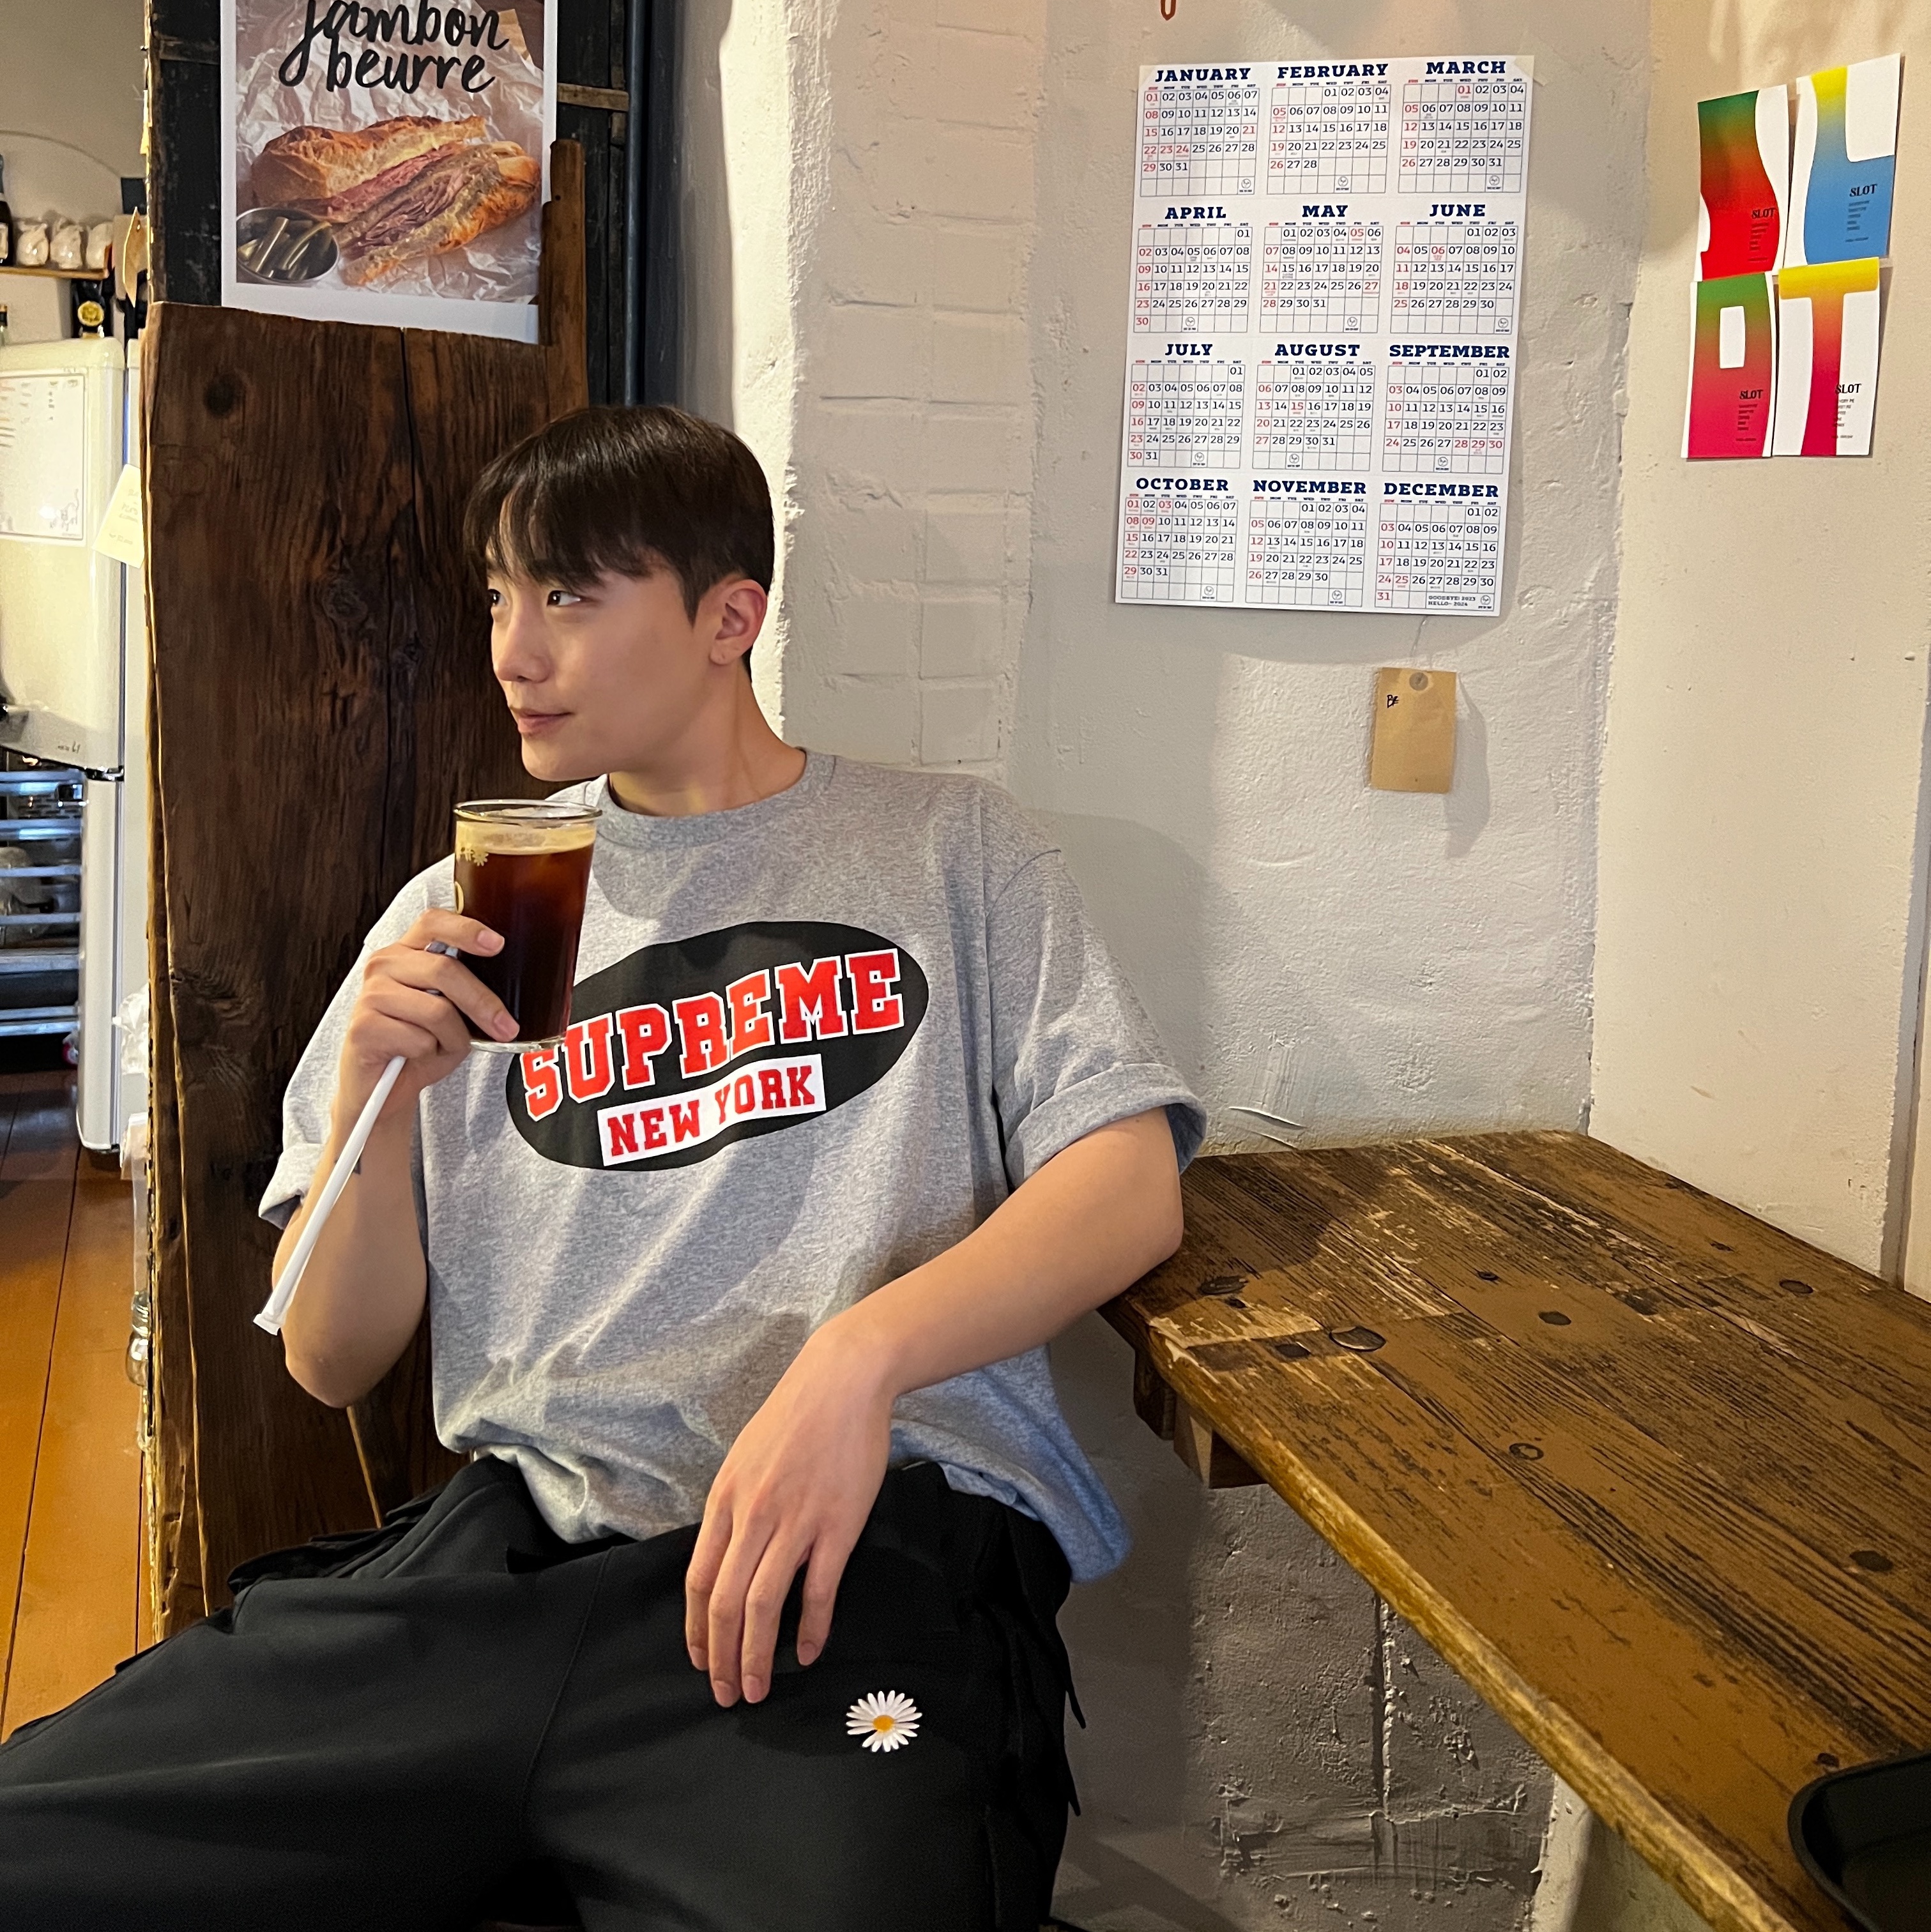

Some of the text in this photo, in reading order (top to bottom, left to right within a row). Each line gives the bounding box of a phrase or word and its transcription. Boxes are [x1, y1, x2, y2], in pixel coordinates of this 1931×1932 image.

[326, 35, 496, 94] beurre
[1426, 61, 1506, 74] MARCH
[1156, 68, 1251, 82] JANUARY
[1278, 64, 1388, 79] FEBRUARY
[1324, 88, 1337, 96] 01
[1341, 88, 1354, 96] 02
[1458, 85, 1523, 94] 01 02 03 04
[1146, 93, 1158, 102] 01
[1163, 93, 1175, 101] 02
[1211, 91, 1224, 100] 05
[1145, 110, 1158, 119] 08
[1194, 109, 1206, 118] 11
[1227, 109, 1240, 117] 13
[1244, 108, 1256, 116] 14
[1273, 107, 1286, 116] 05
[1289, 107, 1302, 115] 06
[1306, 107, 1319, 115] 07
[1323, 106, 1336, 114] 08
[1358, 105, 1371, 114] 10
[1405, 104, 1418, 113] 05
[1422, 104, 1435, 112] 06
[1456, 103, 1470, 112] 08
[1474, 104, 1488, 112] 09
[1492, 103, 1506, 112] 10
[1509, 103, 1522, 112] 11
[1849, 183, 1877, 197] SLOT
[1165, 207, 1226, 219] APRIL
[1302, 205, 1348, 217] MAY
[1430, 204, 1485, 217] JUNE
[1752, 208, 1776, 219] SLOT
[1300, 229, 1313, 237] 02
[1317, 229, 1330, 237] 03
[1333, 228, 1347, 237] 04
[1350, 228, 1364, 237] 05
[1467, 228, 1480, 236] 01
[1485, 228, 1498, 236] 02
[1139, 248, 1152, 256] 02
[1219, 247, 1233, 255] 07
[1266, 247, 1279, 255] 07
[1282, 247, 1295, 255] 08
[1367, 246, 1380, 254] 13
[1396, 246, 1410, 254] 04
[1414, 246, 1428, 254] 05
[1431, 246, 1445, 254] 06
[1449, 246, 1462, 254] 07
[1466, 246, 1479, 254] 08
[1483, 246, 1497, 254] 09
[1165, 344, 1212, 355] JULY
[1275, 344, 1360, 356] AUGUST
[1390, 345, 1509, 358] SEPTEMBER
[1325, 367, 1339, 376] 03
[1359, 368, 1373, 376] 05
[1133, 383, 1145, 392] 02
[1149, 383, 1161, 392] 03
[1229, 384, 1242, 392] 08
[1291, 384, 1304, 393] 08
[1308, 384, 1322, 393] 09
[1342, 385, 1355, 393] 11
[1359, 385, 1372, 393] 12
[1389, 386, 1402, 394] 03
[1406, 386, 1419, 394] 04
[1423, 386, 1437, 394] 05
[1457, 386, 1471, 395] 07
[1474, 386, 1488, 395] 08
[1492, 387, 1506, 395] 09
[1835, 383, 1861, 395] SLOT
[1739, 389, 1764, 400] SLOT
[1136, 478, 1228, 491] OCTOBER
[1253, 480, 1366, 494] NOVEMBER
[1384, 483, 1498, 497] DECEMBER
[1158, 500, 1172, 508] 03
[1175, 501, 1187, 509] 04
[1318, 504, 1331, 512] 02
[1334, 505, 1348, 513] 03
[1467, 508, 1498, 517] 01 02
[1251, 519, 1264, 528] 05
[1284, 521, 1297, 529] 07
[1317, 521, 1331, 529] 09
[1335, 522, 1347, 530] 10
[1381, 523, 1497, 534] 03 04 05 06 07 08 09
[520, 948, 904, 1122] SUPREME
[607, 1065, 815, 1157] NEW YORK
